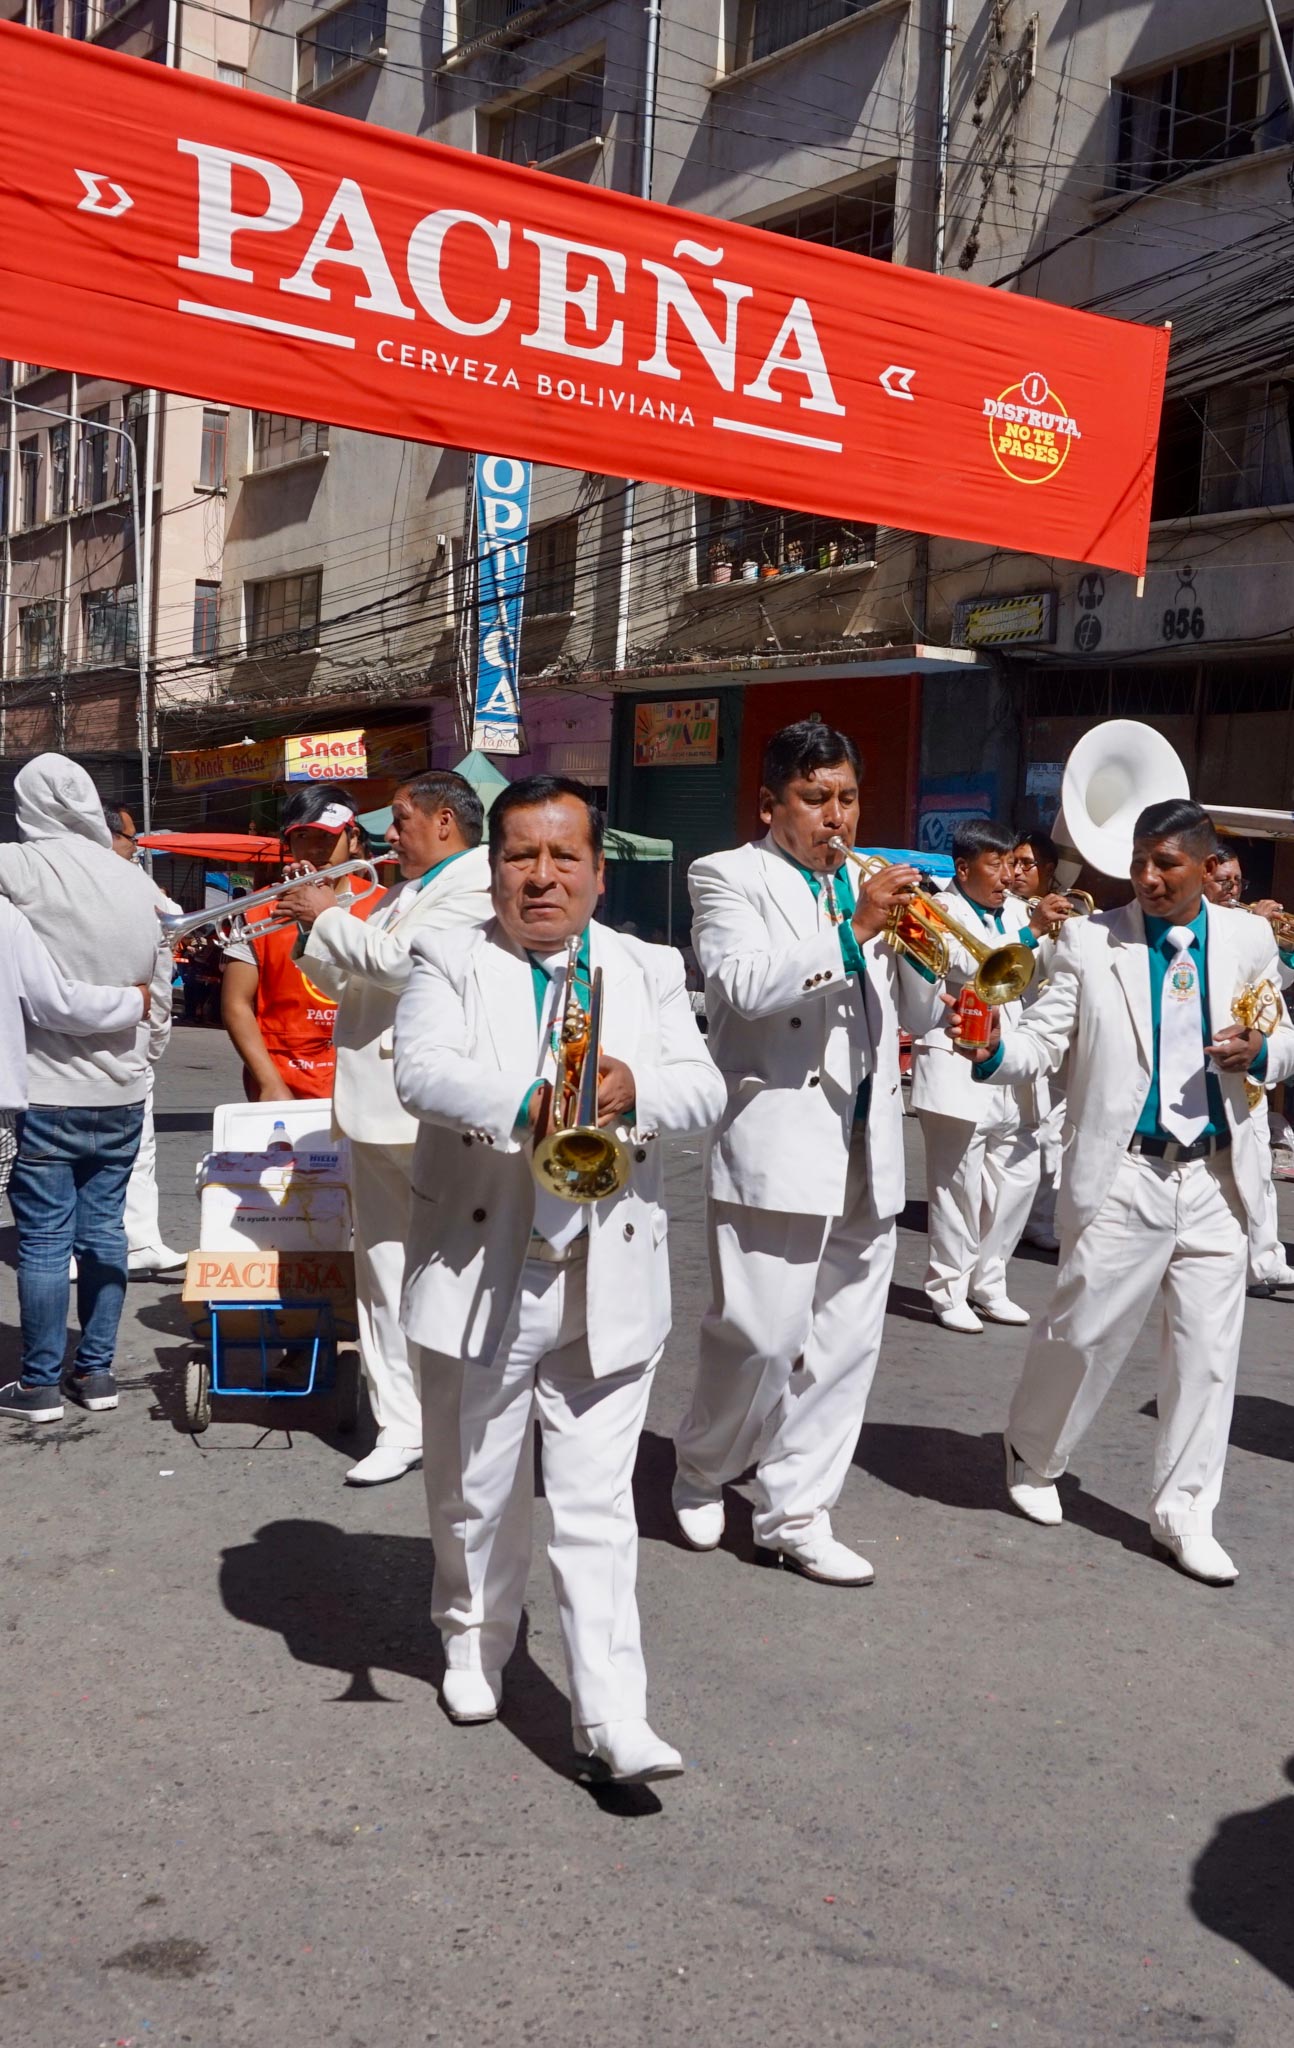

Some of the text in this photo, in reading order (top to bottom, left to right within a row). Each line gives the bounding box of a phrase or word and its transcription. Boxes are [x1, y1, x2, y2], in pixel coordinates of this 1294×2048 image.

[177, 138, 846, 416] PACEÑA
[377, 340, 695, 428] CERVEZA BOLIVIANA
[982, 397, 1082, 440] DISFRUTA,
[1005, 421, 1055, 446] NO TE
[998, 435, 1060, 465] PASES
[481, 454, 529, 713] OPTICA
[1162, 606, 1205, 642] 856
[194, 754, 225, 778] Snack
[195, 1257, 347, 1289] PACEÑA
